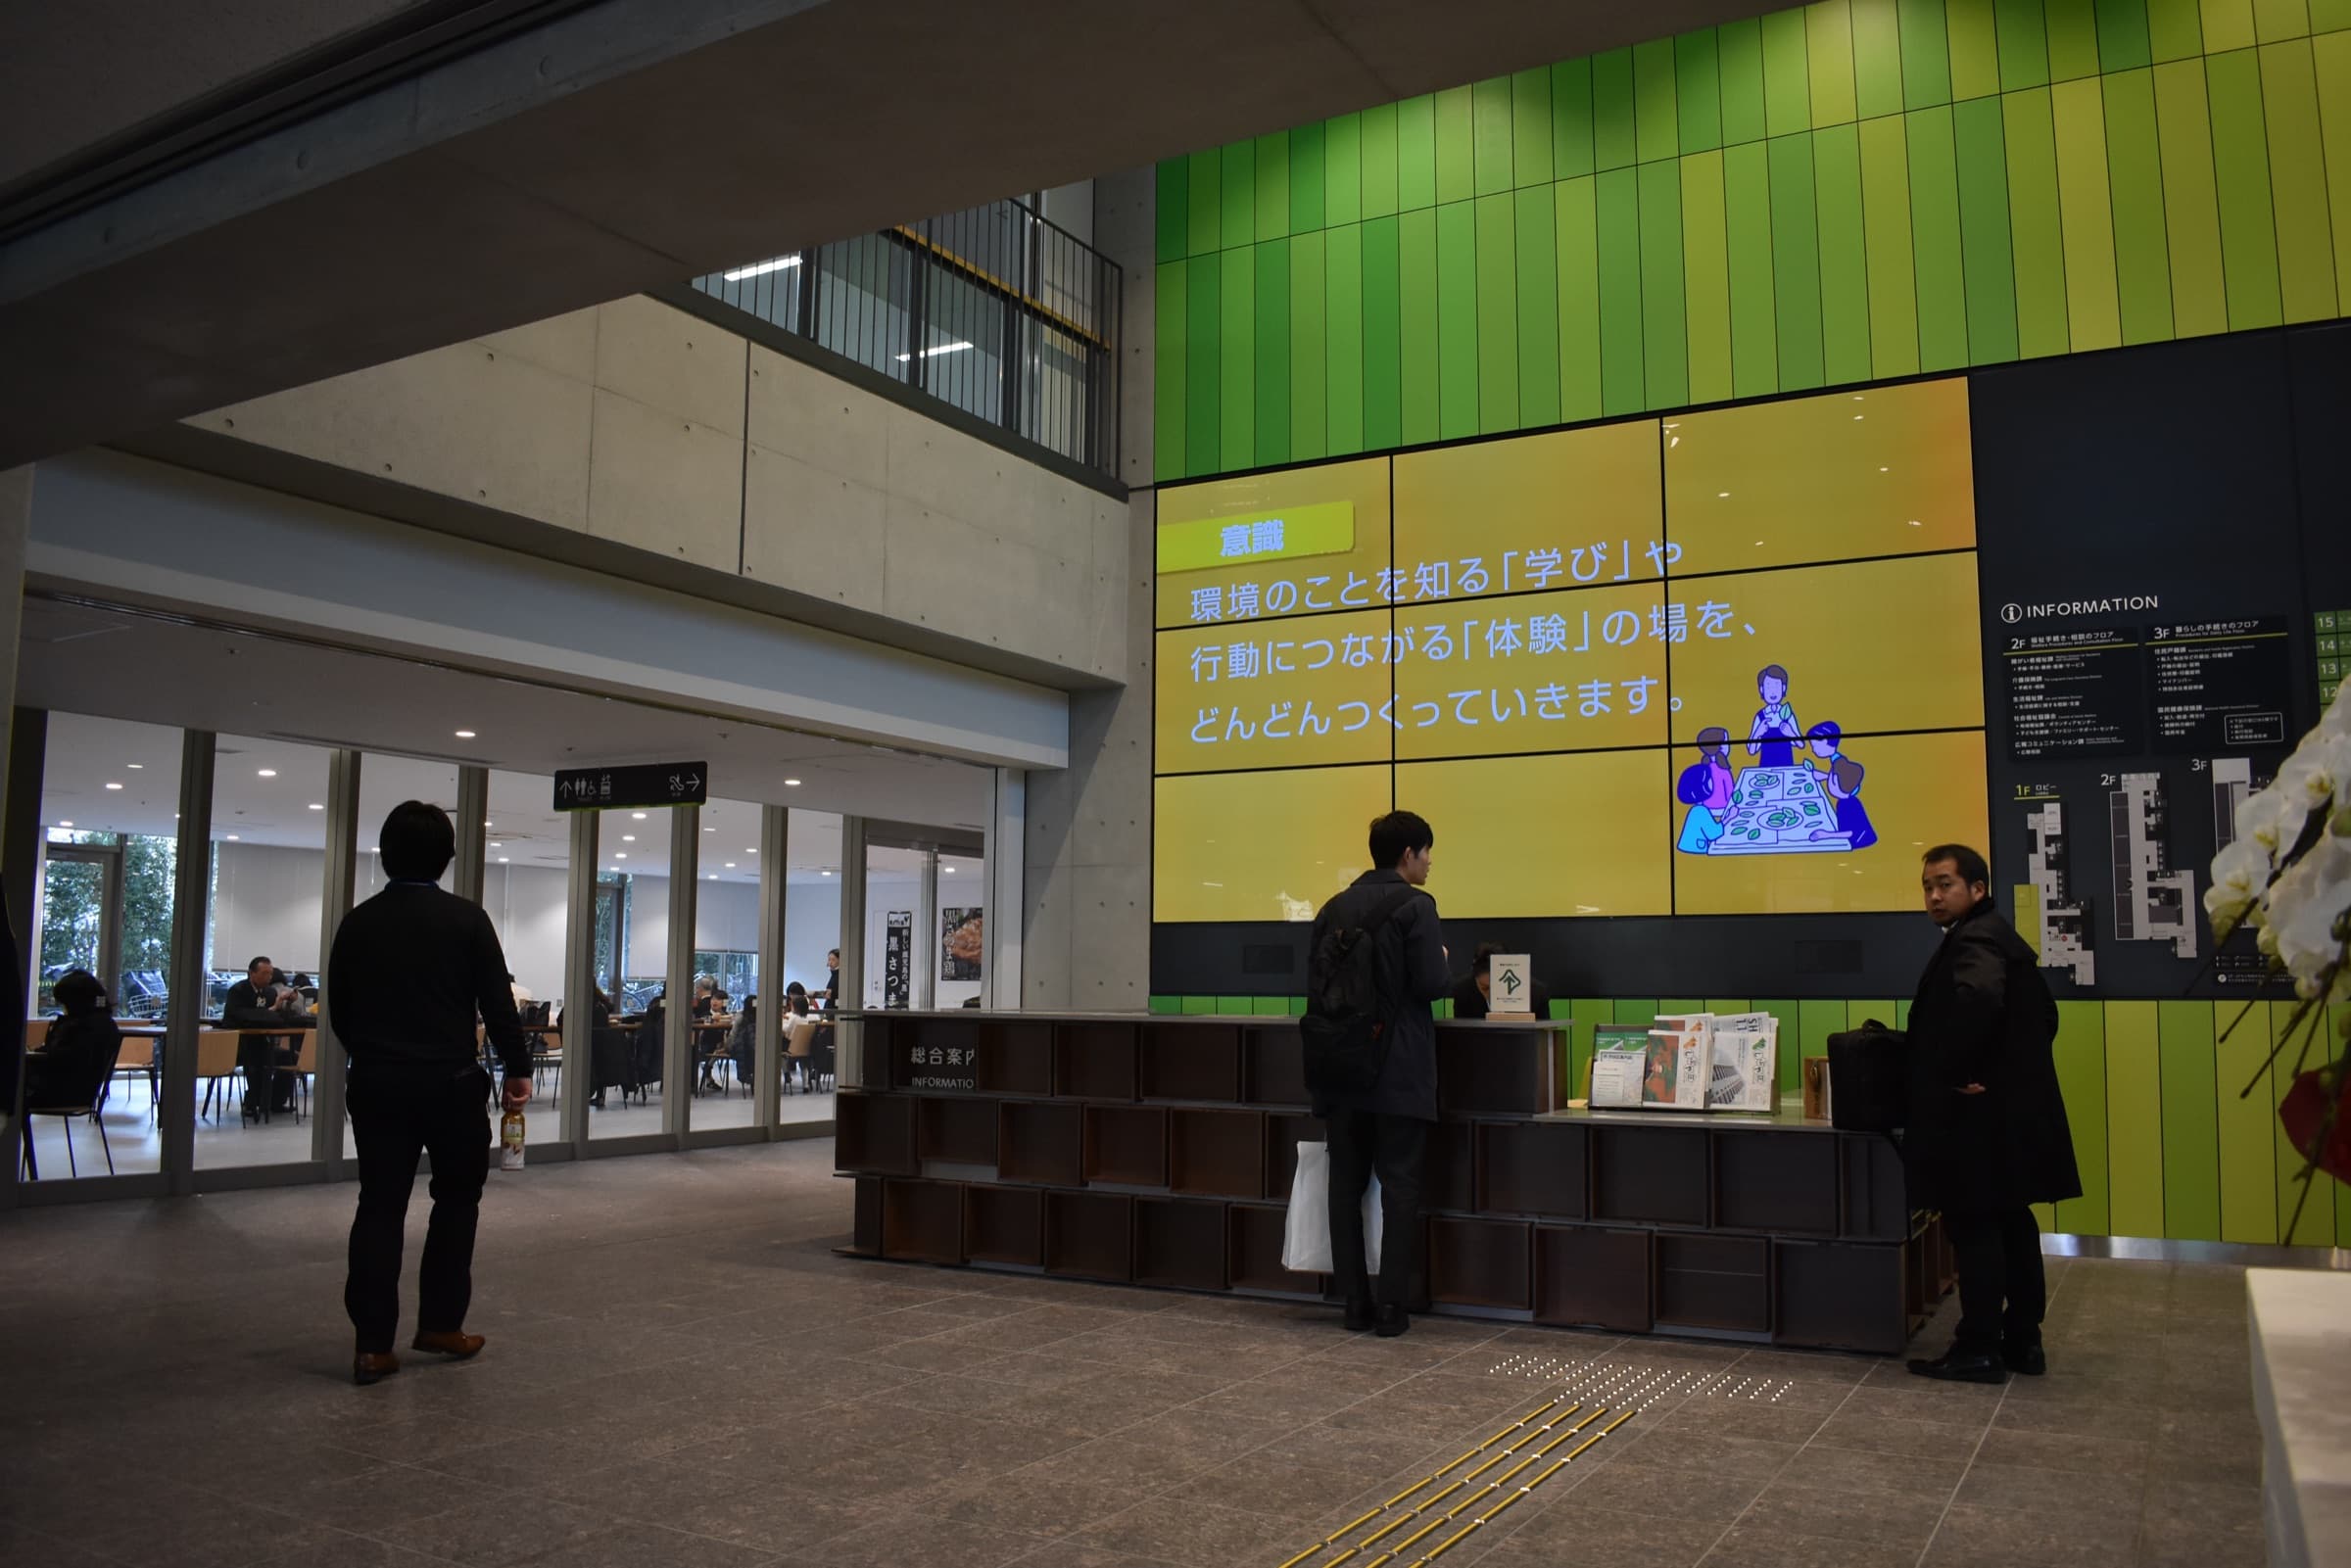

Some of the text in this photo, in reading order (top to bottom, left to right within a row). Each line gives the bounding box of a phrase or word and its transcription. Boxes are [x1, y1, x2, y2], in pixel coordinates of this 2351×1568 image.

[1221, 519, 1284, 557] 意識
[1190, 539, 1683, 623] 環境のことを知る「学び」や
[2027, 595, 2158, 618] INFORMATION
[2318, 617, 2334, 628] 15
[2154, 627, 2170, 640] 3F
[1190, 600, 1756, 683] 行動につながる「体験」の場を、
[2011, 638, 2026, 649] 2F
[2320, 640, 2335, 651] 14
[2321, 663, 2337, 675] 13
[2323, 687, 2337, 698] 12
[1189, 675, 1683, 743] どんどんつくっていきます。
[2191, 759, 2207, 771] 3F
[2100, 774, 2116, 786] 2F
[2015, 784, 2031, 797] 1F
[911, 1075, 974, 1090] INFORMATIO
